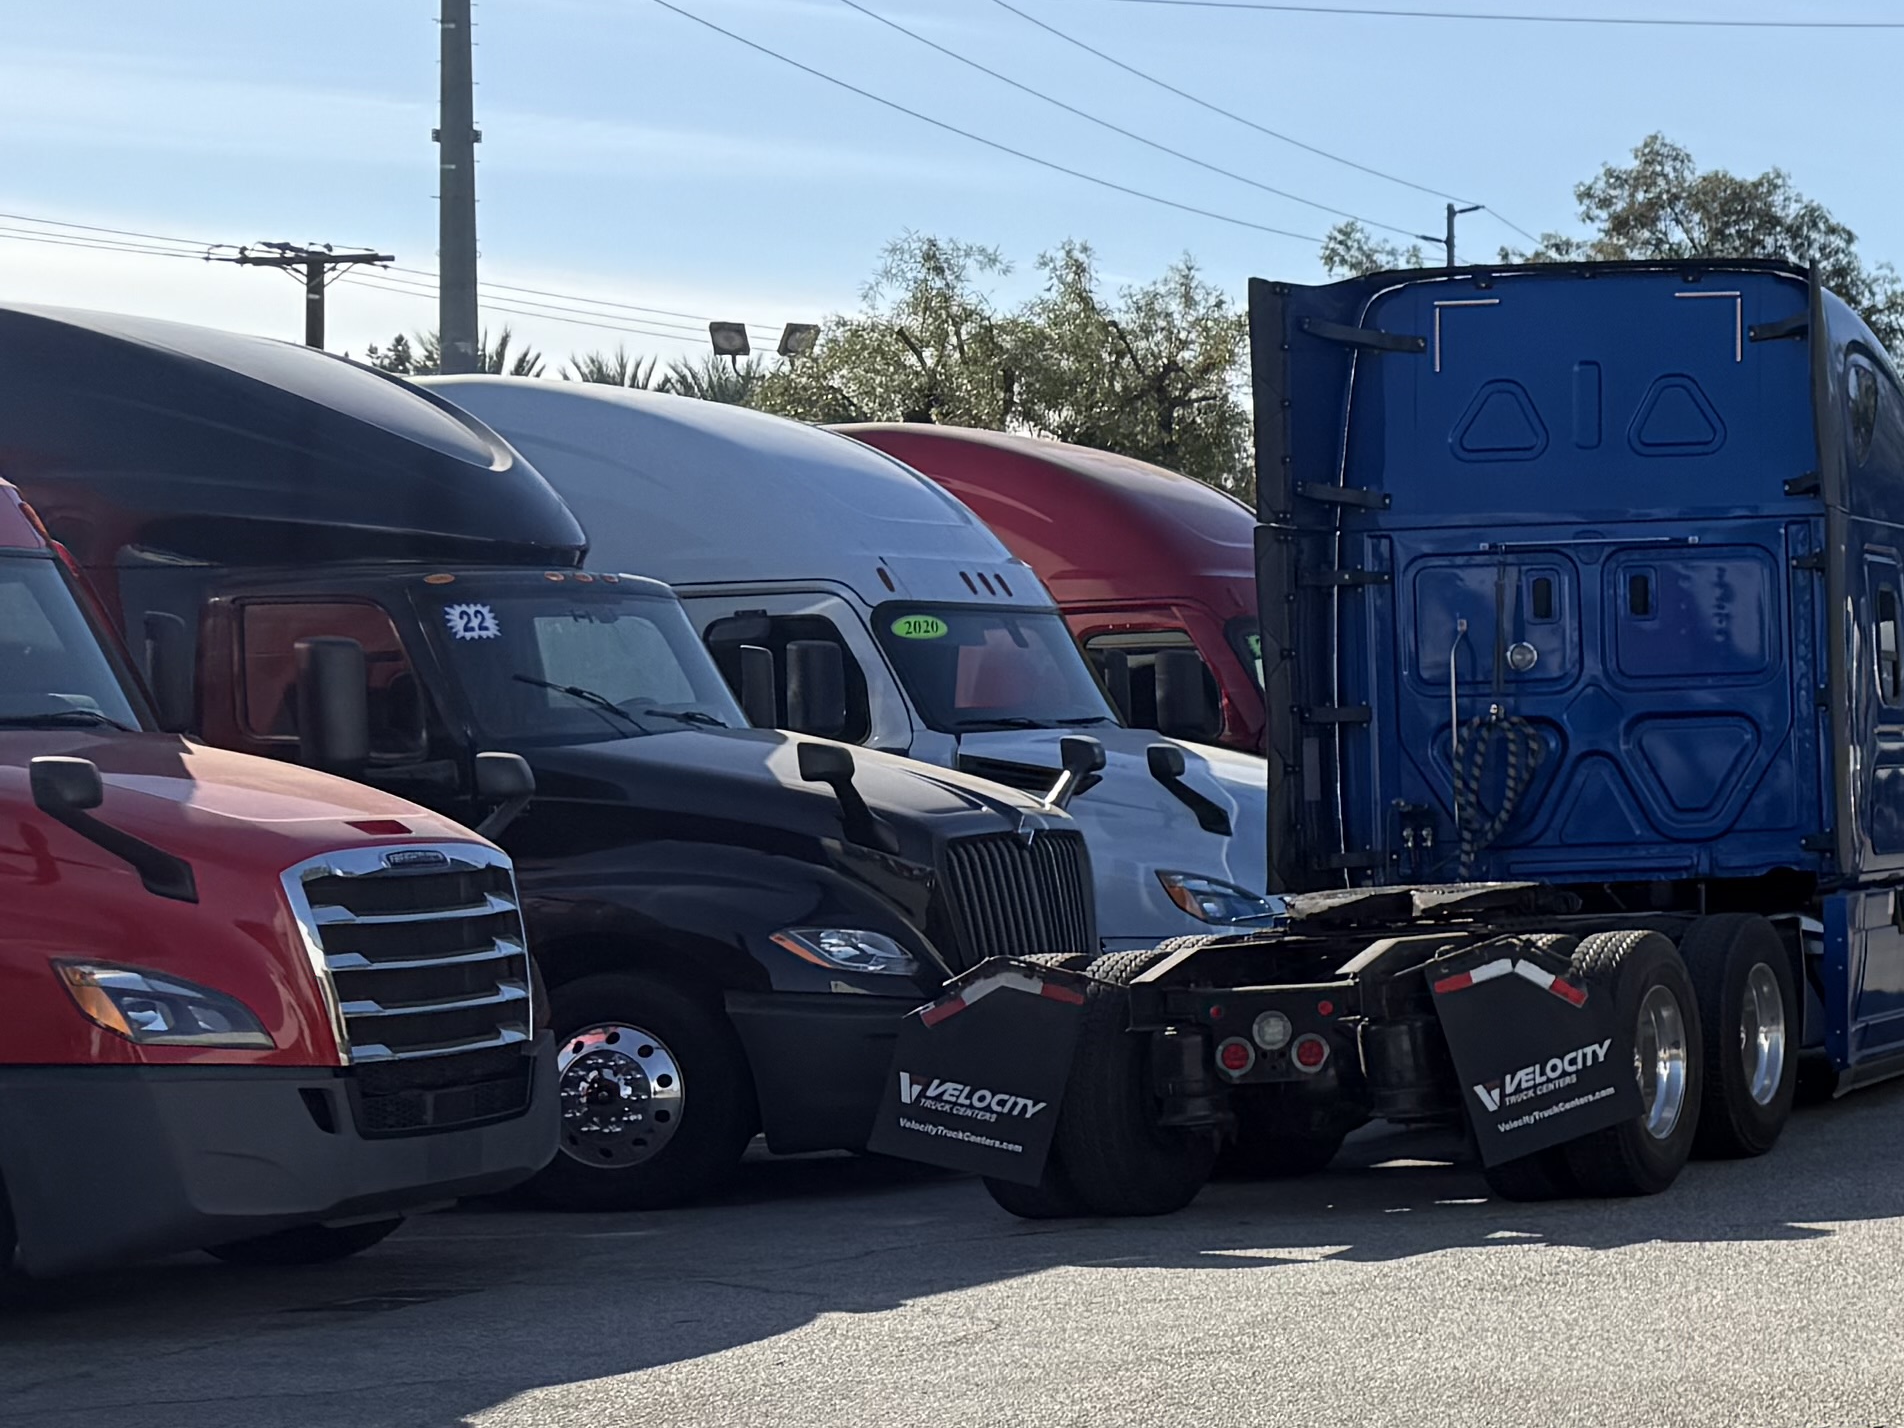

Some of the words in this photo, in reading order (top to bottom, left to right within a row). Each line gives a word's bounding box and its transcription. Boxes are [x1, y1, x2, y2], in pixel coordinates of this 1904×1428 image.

[458, 609, 490, 633] 22
[903, 619, 939, 635] 2020
[1504, 1038, 1612, 1095] VELOCITY
[925, 1079, 1047, 1119] VELOCITY
[1504, 1088, 1535, 1106] TRUCK
[1536, 1074, 1577, 1096] CENTERS
[919, 1098, 953, 1113] TRUCK
[953, 1106, 998, 1122] CENTERS
[900, 1117, 1023, 1153] VelocityTruckCenters.com
